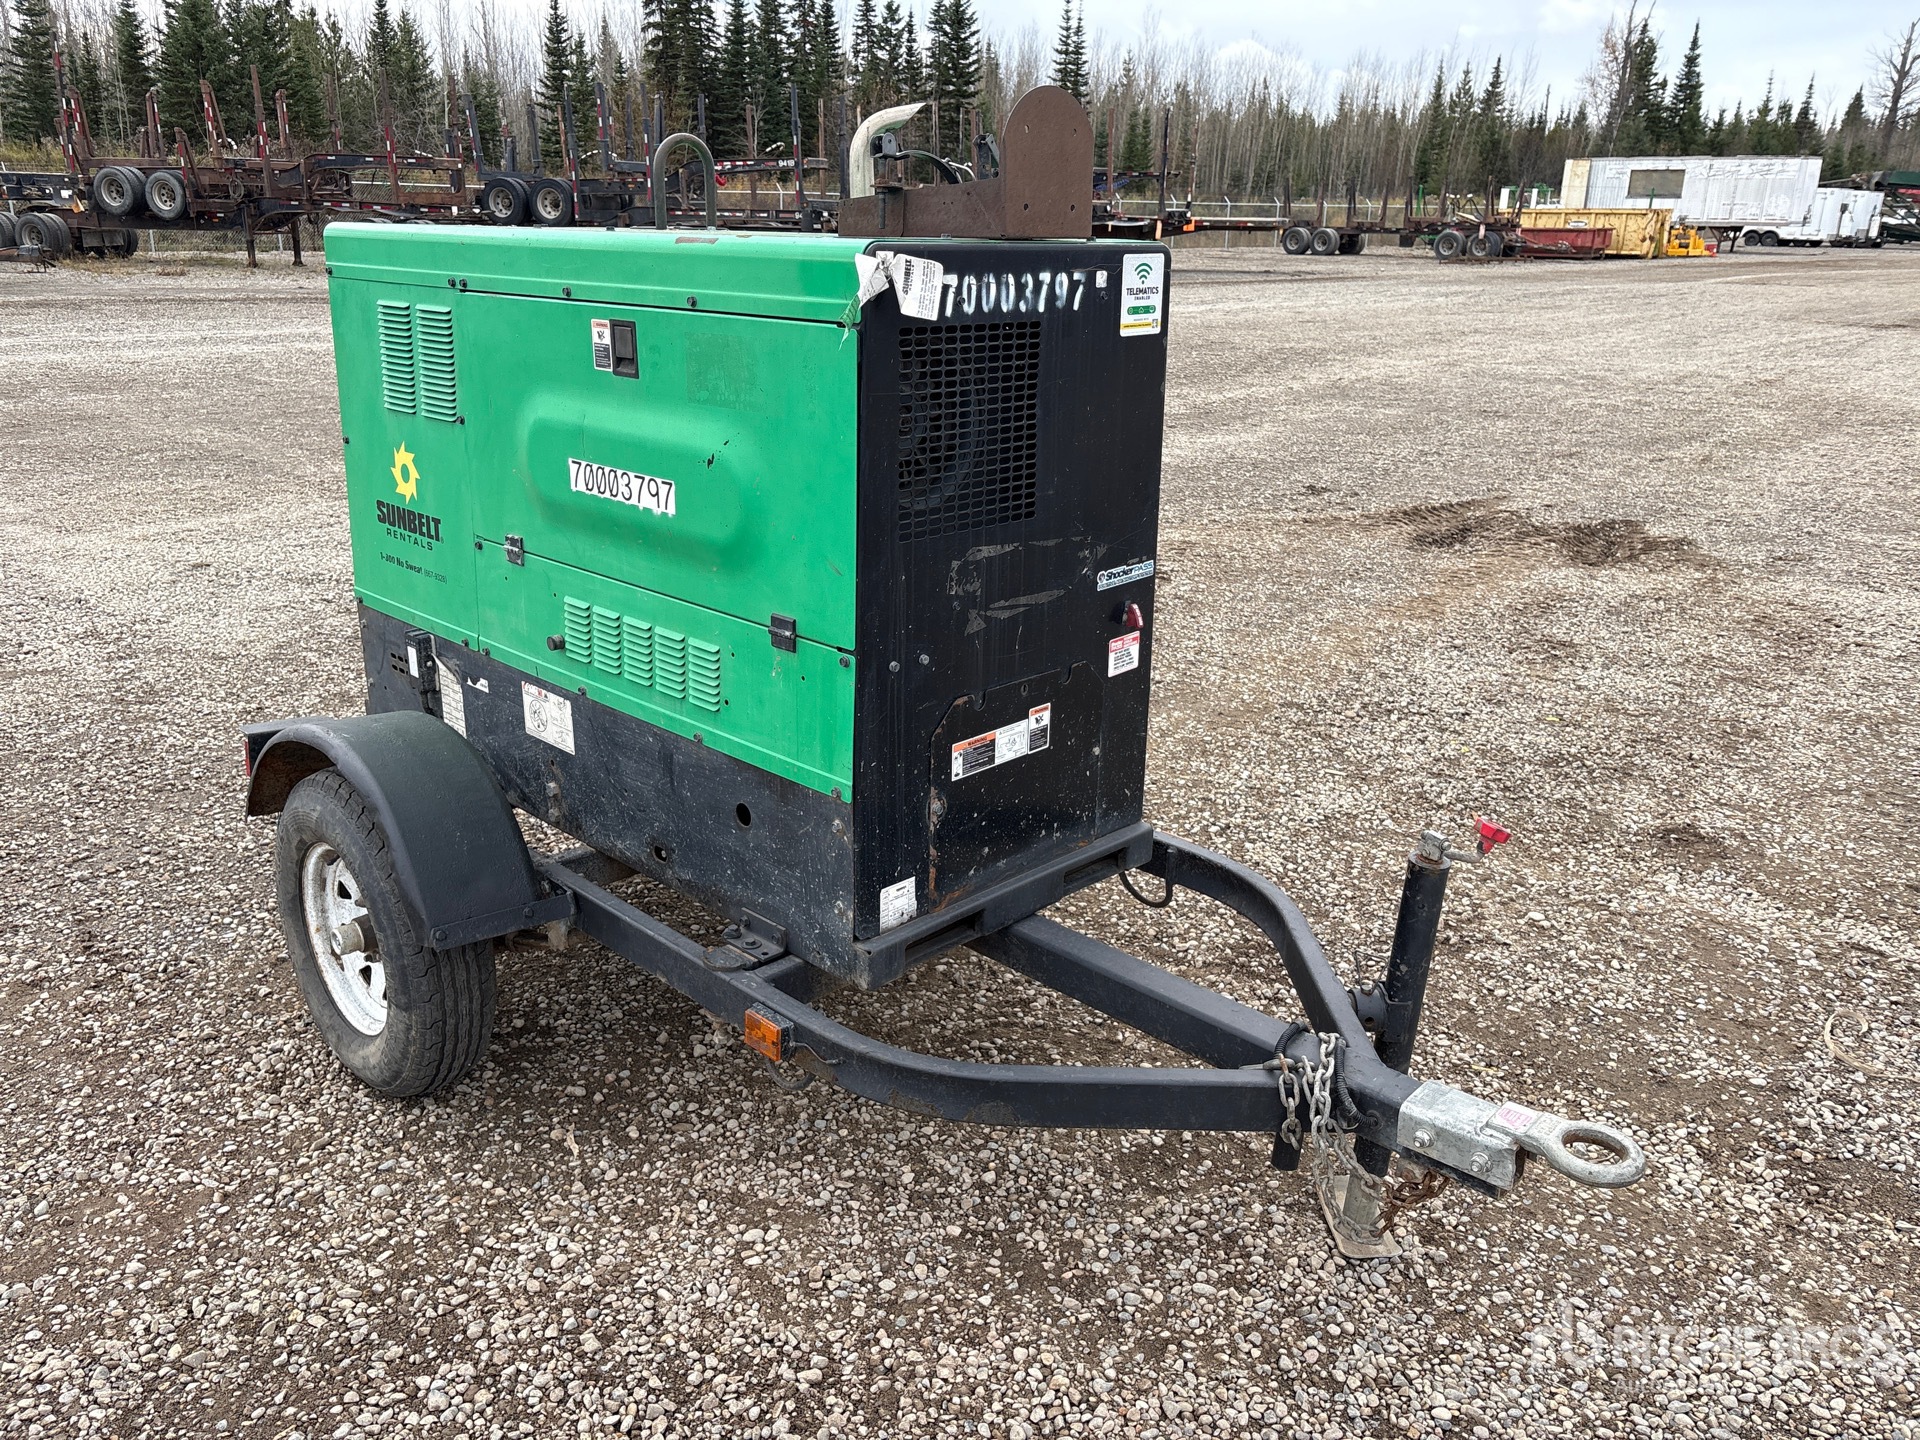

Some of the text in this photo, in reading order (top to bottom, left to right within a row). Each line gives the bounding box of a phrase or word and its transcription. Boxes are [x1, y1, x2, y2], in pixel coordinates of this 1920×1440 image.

[942, 271, 1087, 318] 70003797
[1126, 286, 1159, 296] TELEMATICS
[571, 459, 673, 511] 70003797
[376, 499, 441, 542] SUNBELT
[386, 527, 433, 551] RENTALS
[396, 557, 405, 568] No
[967, 735, 988, 747] WARNING
